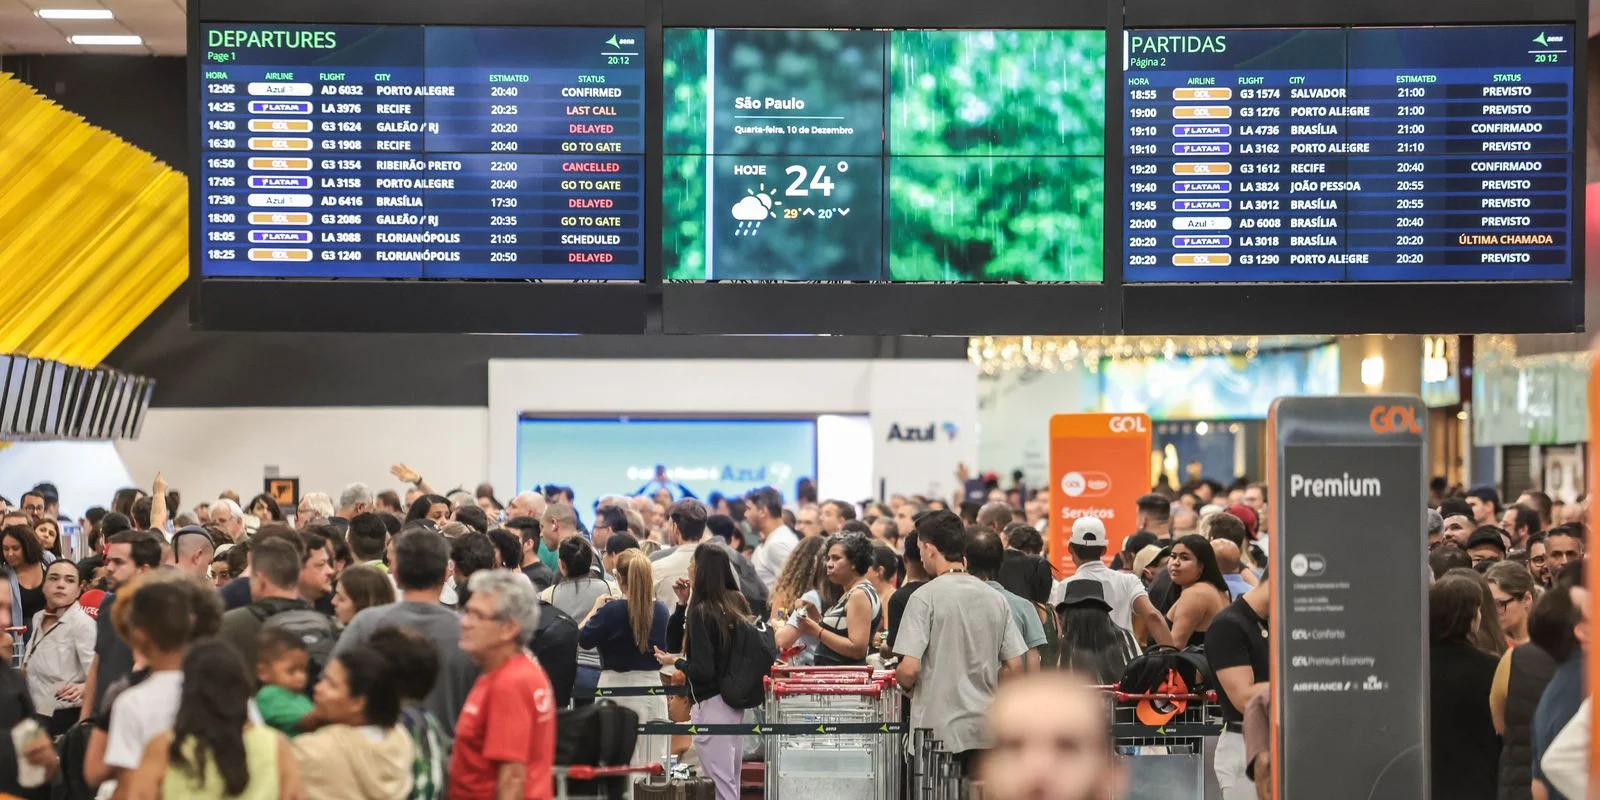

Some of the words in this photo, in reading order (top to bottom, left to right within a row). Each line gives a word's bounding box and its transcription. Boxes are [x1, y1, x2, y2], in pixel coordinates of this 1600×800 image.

[208, 30, 337, 49] DEPARTURES
[1131, 35, 1226, 54] PARTIDAS
[207, 51, 230, 63] Page
[231, 51, 236, 61] 1
[607, 56, 630, 65] 20:12
[1130, 57, 1159, 69] Página
[1160, 57, 1166, 67] 2
[205, 71, 228, 80] HORA
[265, 72, 294, 81] AIRLINE
[319, 72, 346, 81] FLIGHT
[374, 73, 391, 82] CITY
[489, 74, 530, 83] ESTIMATED
[578, 75, 606, 83] STATUS
[1128, 77, 1150, 86] HORA
[1187, 77, 1216, 85] AIRLINE
[1238, 76, 1264, 85] FLIGHT
[1288, 76, 1306, 84] CITY
[1396, 74, 1437, 83] ESTIMATED
[1493, 73, 1522, 82] STATUS
[207, 83, 236, 94] 12:05
[338, 85, 364, 96] 6032
[376, 85, 413, 96] PORTO
[490, 86, 518, 97] 20:40
[561, 87, 622, 98] CONFIRMED
[1130, 89, 1157, 100] 18:55
[1255, 88, 1281, 99] 1574
[1290, 88, 1347, 99] SALVADOR
[1397, 87, 1426, 98] 21:00
[1482, 86, 1532, 97] PREVISTO
[207, 102, 236, 112] 14:25
[336, 103, 362, 114] 3976
[376, 103, 412, 114] RECIFE
[490, 104, 518, 115] 20:25
[566, 105, 591, 115] LAST
[592, 106, 617, 116] CALL
[734, 96, 762, 110] São
[764, 96, 805, 110] Paulo
[1129, 108, 1157, 118] 19:00
[1255, 107, 1281, 117] 1276
[1290, 106, 1327, 117] PORTO
[1397, 105, 1425, 116] 21:00
[1482, 104, 1532, 115] PREVISTO
[207, 120, 236, 131] 14:30
[337, 121, 362, 132] 1624
[376, 120, 419, 132] GALEÃO
[490, 123, 518, 133] 20:20
[569, 124, 614, 134] DELAYED
[734, 125, 785, 135] Quarta-feira,
[786, 125, 798, 135] 10
[798, 125, 810, 135] de
[811, 126, 854, 135] Dezembro
[1129, 126, 1157, 136] 19:10
[1190, 127, 1220, 135] LATAM
[1254, 125, 1280, 136] 4736
[1290, 122, 1338, 135] BRASÍLIA
[1397, 124, 1425, 134] 21:00
[1471, 122, 1543, 134] CONFIRMADO
[207, 138, 236, 149] 16:30
[337, 139, 362, 150] 1908
[376, 140, 412, 151] RECIFE
[490, 141, 518, 151] 20:40
[595, 142, 622, 152] GATE
[1129, 144, 1157, 155] 19:10
[1254, 143, 1280, 154] 3162
[1290, 143, 1327, 153] PORTO
[1397, 142, 1425, 153] 21:10
[1482, 141, 1532, 152] PREVISTO
[207, 158, 236, 169] 16:50
[337, 159, 362, 170] 1354
[376, 158, 427, 171] RIBEIRÃO
[428, 160, 462, 171] PRETO
[490, 161, 518, 172] 22:00
[562, 162, 620, 172] CANCELLED
[733, 164, 767, 176] HOJE
[1130, 164, 1157, 175] 19:20
[1256, 163, 1280, 174] 1612
[1290, 163, 1326, 174] RECIFE
[1396, 162, 1425, 173] 20:40
[1470, 161, 1543, 172] CONFIRMADO
[207, 176, 236, 187] 17:05
[336, 177, 362, 188] 3158
[376, 178, 413, 189] PORTO
[490, 179, 518, 190] 20:40
[595, 180, 621, 190] GATE
[1130, 182, 1157, 193] 19:40
[1190, 183, 1220, 191] LATAM
[1254, 181, 1280, 192] 3824
[1289, 179, 1319, 194] JOÃO
[1396, 180, 1425, 191] 20:55
[1481, 179, 1531, 190] PREVISTO
[207, 194, 236, 205] 17:30
[337, 196, 364, 207] 6416
[376, 194, 424, 207] BRASÍLIA
[490, 197, 518, 208] 17:30
[568, 198, 613, 209] DELAYED
[1129, 200, 1157, 211] 19:45
[1254, 199, 1280, 210] 3012
[1290, 197, 1338, 210] BRASÍLIA
[1396, 199, 1424, 209] 20:55
[1481, 198, 1531, 208] PREVISTO
[207, 213, 236, 223] 18:00
[336, 214, 362, 225] 2086
[376, 212, 419, 225] GALEÃO
[490, 215, 518, 226] 20:35
[594, 216, 621, 227] GATE
[1129, 218, 1157, 229] 20:00
[1256, 218, 1282, 228] 6008
[1290, 215, 1338, 228] BRASÍLIA
[1396, 217, 1424, 227] 20:40
[1481, 216, 1531, 227] PREVISTO
[207, 231, 236, 242] 18:05
[336, 232, 362, 243] 3088
[376, 230, 461, 244] FLORIANÓPOLIS
[490, 233, 518, 244] 21:05
[561, 234, 621, 245] SCHEDULED
[1129, 236, 1157, 247] 20:20
[1190, 238, 1220, 246] LATAM
[1254, 236, 1280, 247] 3018
[1290, 233, 1338, 246] BRASÍLIA
[1396, 235, 1424, 246] 20:20
[1458, 233, 1499, 245] ÚLTIMA
[1499, 234, 1553, 245] CHAMADA
[207, 249, 236, 260] 18:25
[337, 250, 362, 261] 1240
[376, 248, 461, 262] FLORIANÓPOLIS
[490, 252, 518, 262] 20:50
[568, 252, 613, 263] DELAYED
[1129, 255, 1157, 265] 20:20
[1255, 254, 1280, 265] 1290
[1290, 254, 1327, 264] PORTO
[1396, 253, 1424, 264] 20:20
[1481, 253, 1531, 263] PREVISTO
[1109, 416, 1147, 433] GOL
[1370, 405, 1423, 433] GOL
[888, 421, 937, 442] Azul
[1290, 473, 1382, 498] Premium
[1311, 629, 1346, 640] Conforto
[1308, 656, 1341, 667] Premium
[1341, 655, 1375, 668] Economy
[1362, 681, 1383, 691] KLM
